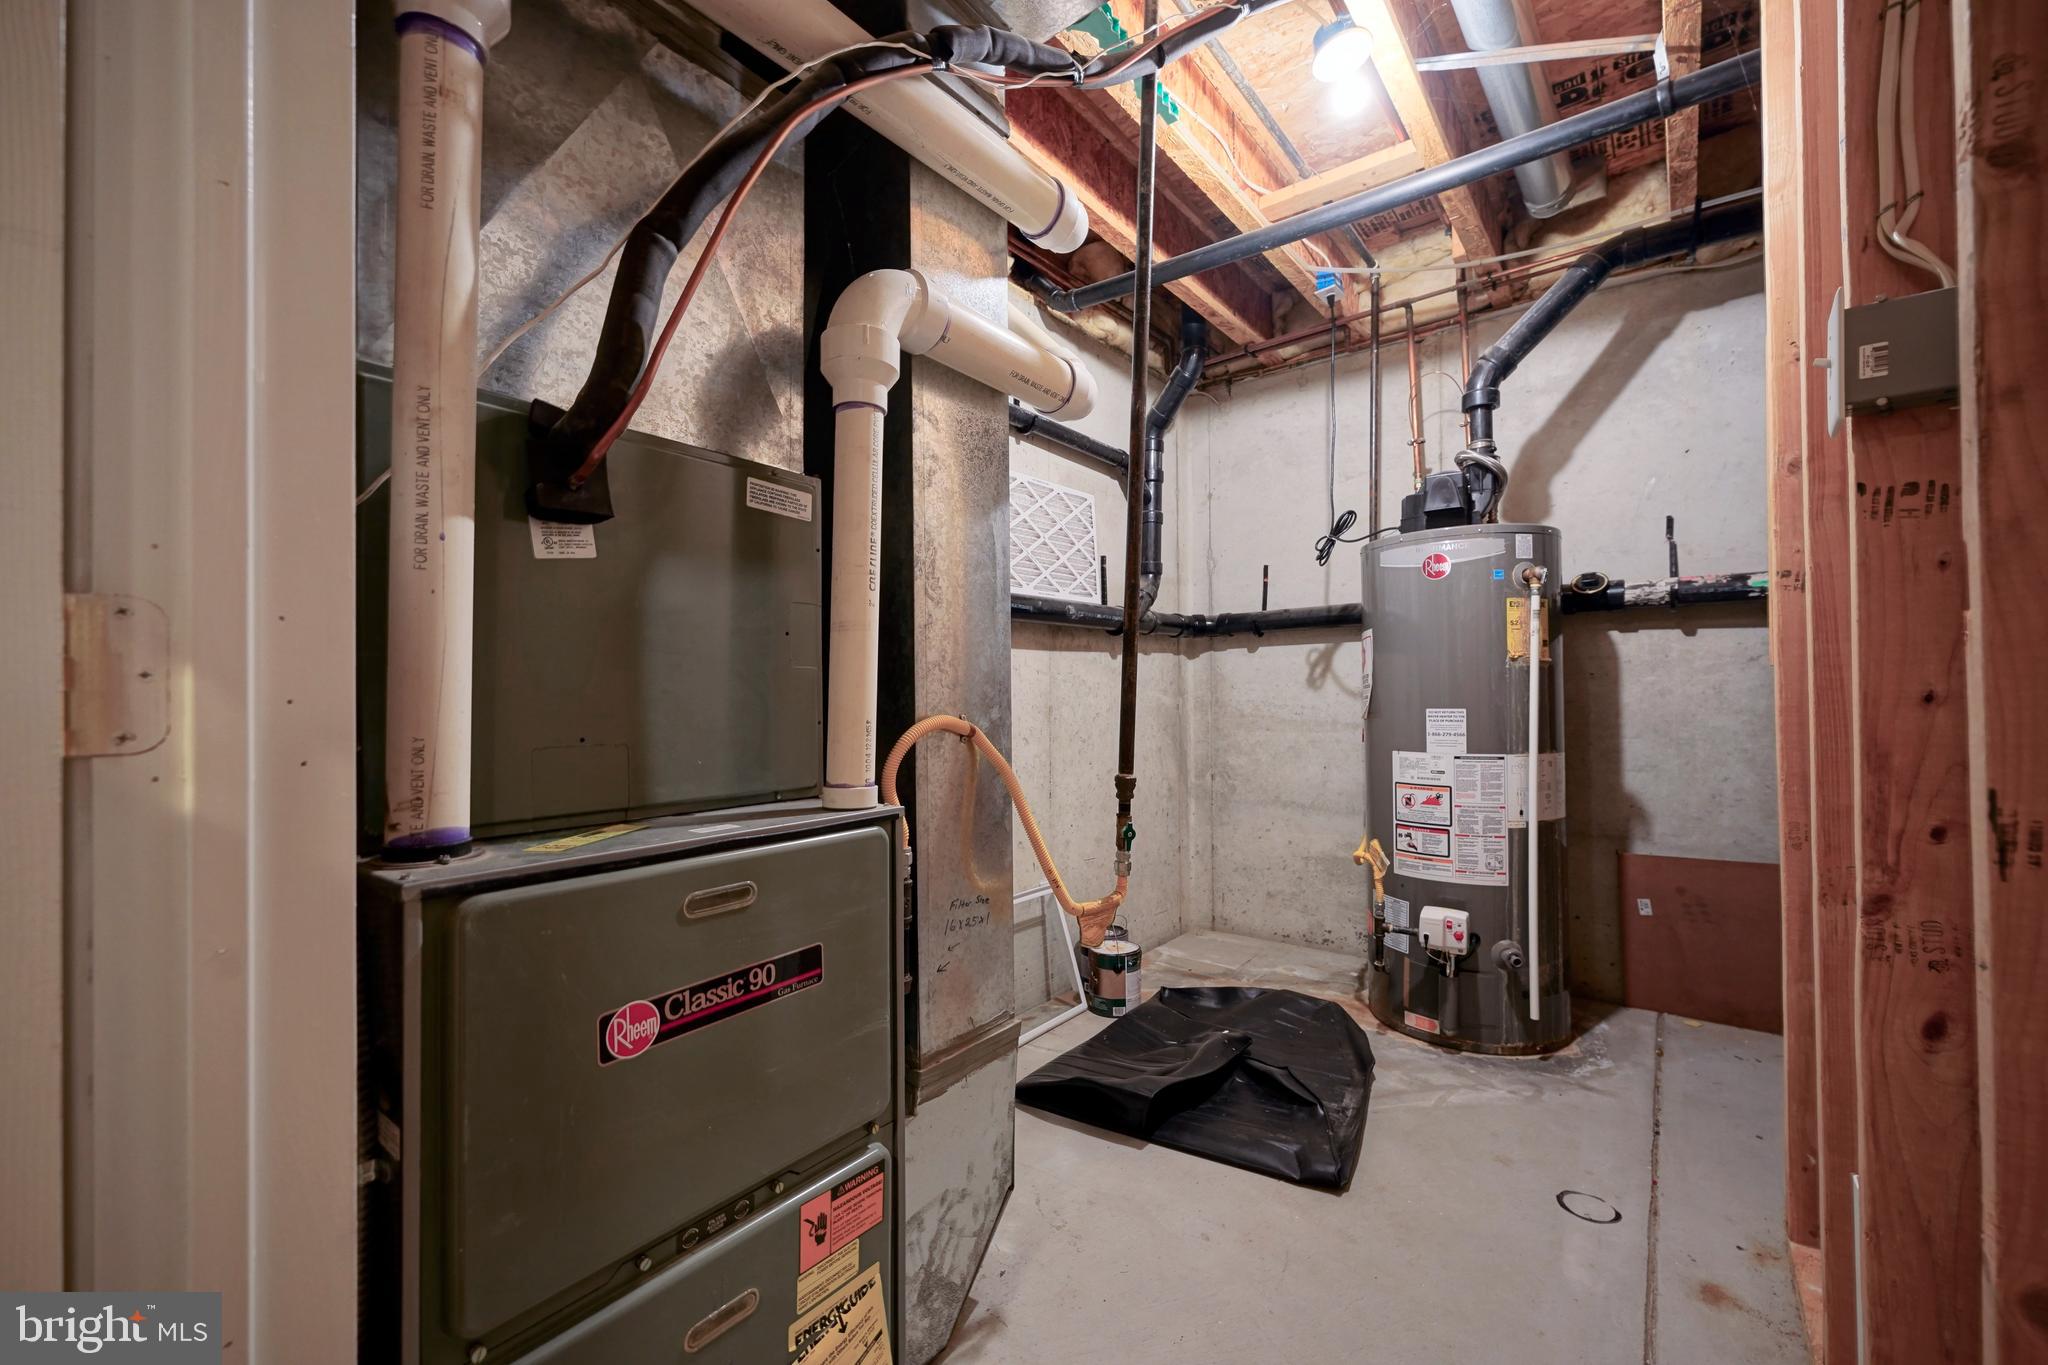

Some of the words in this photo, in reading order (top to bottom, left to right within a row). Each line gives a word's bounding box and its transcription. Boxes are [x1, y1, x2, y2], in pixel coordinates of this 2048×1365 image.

[424, 56, 438, 83] VENT
[424, 85, 438, 109] AND
[422, 110, 437, 148] WASTE
[420, 186, 434, 210] FOR
[418, 385, 431, 414] ONLY
[416, 418, 431, 444] VENT
[416, 446, 430, 468] AND
[416, 471, 430, 512] WASTE
[413, 547, 427, 571] FOR
[410, 737, 425, 766] ONLY
[410, 769, 424, 798] VENT
[410, 797, 425, 820] AND
[1921, 920, 1946, 954] STUD
[664, 978, 744, 1020] Classic
[750, 963, 776, 991] 90
[778, 986, 791, 996] Gas
[792, 976, 818, 992] Furnace
[613, 1007, 659, 1053] Rheem
[845, 1166, 880, 1191] WARNING
